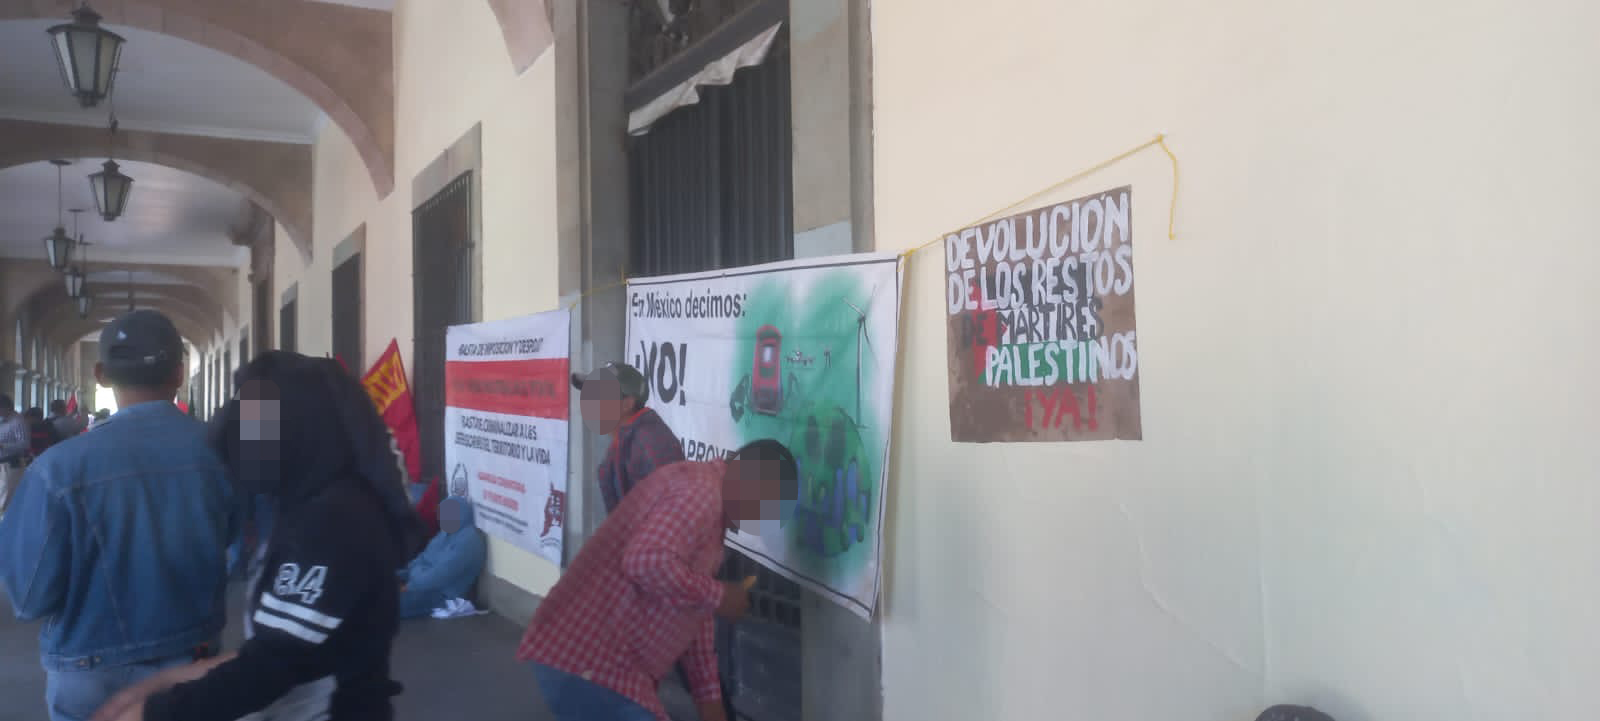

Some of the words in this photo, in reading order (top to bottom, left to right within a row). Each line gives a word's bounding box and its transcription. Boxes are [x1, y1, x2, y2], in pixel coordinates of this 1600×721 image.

[947, 192, 1128, 272] DEVOLUCIÓN
[684, 288, 747, 319] decimos:
[948, 269, 978, 315] DE
[980, 261, 1026, 312] LOS
[1031, 245, 1133, 305] RESTOS
[962, 313, 988, 346] DE
[985, 330, 1138, 388] PALESTINOS
[1025, 384, 1098, 431] ¡YA!
